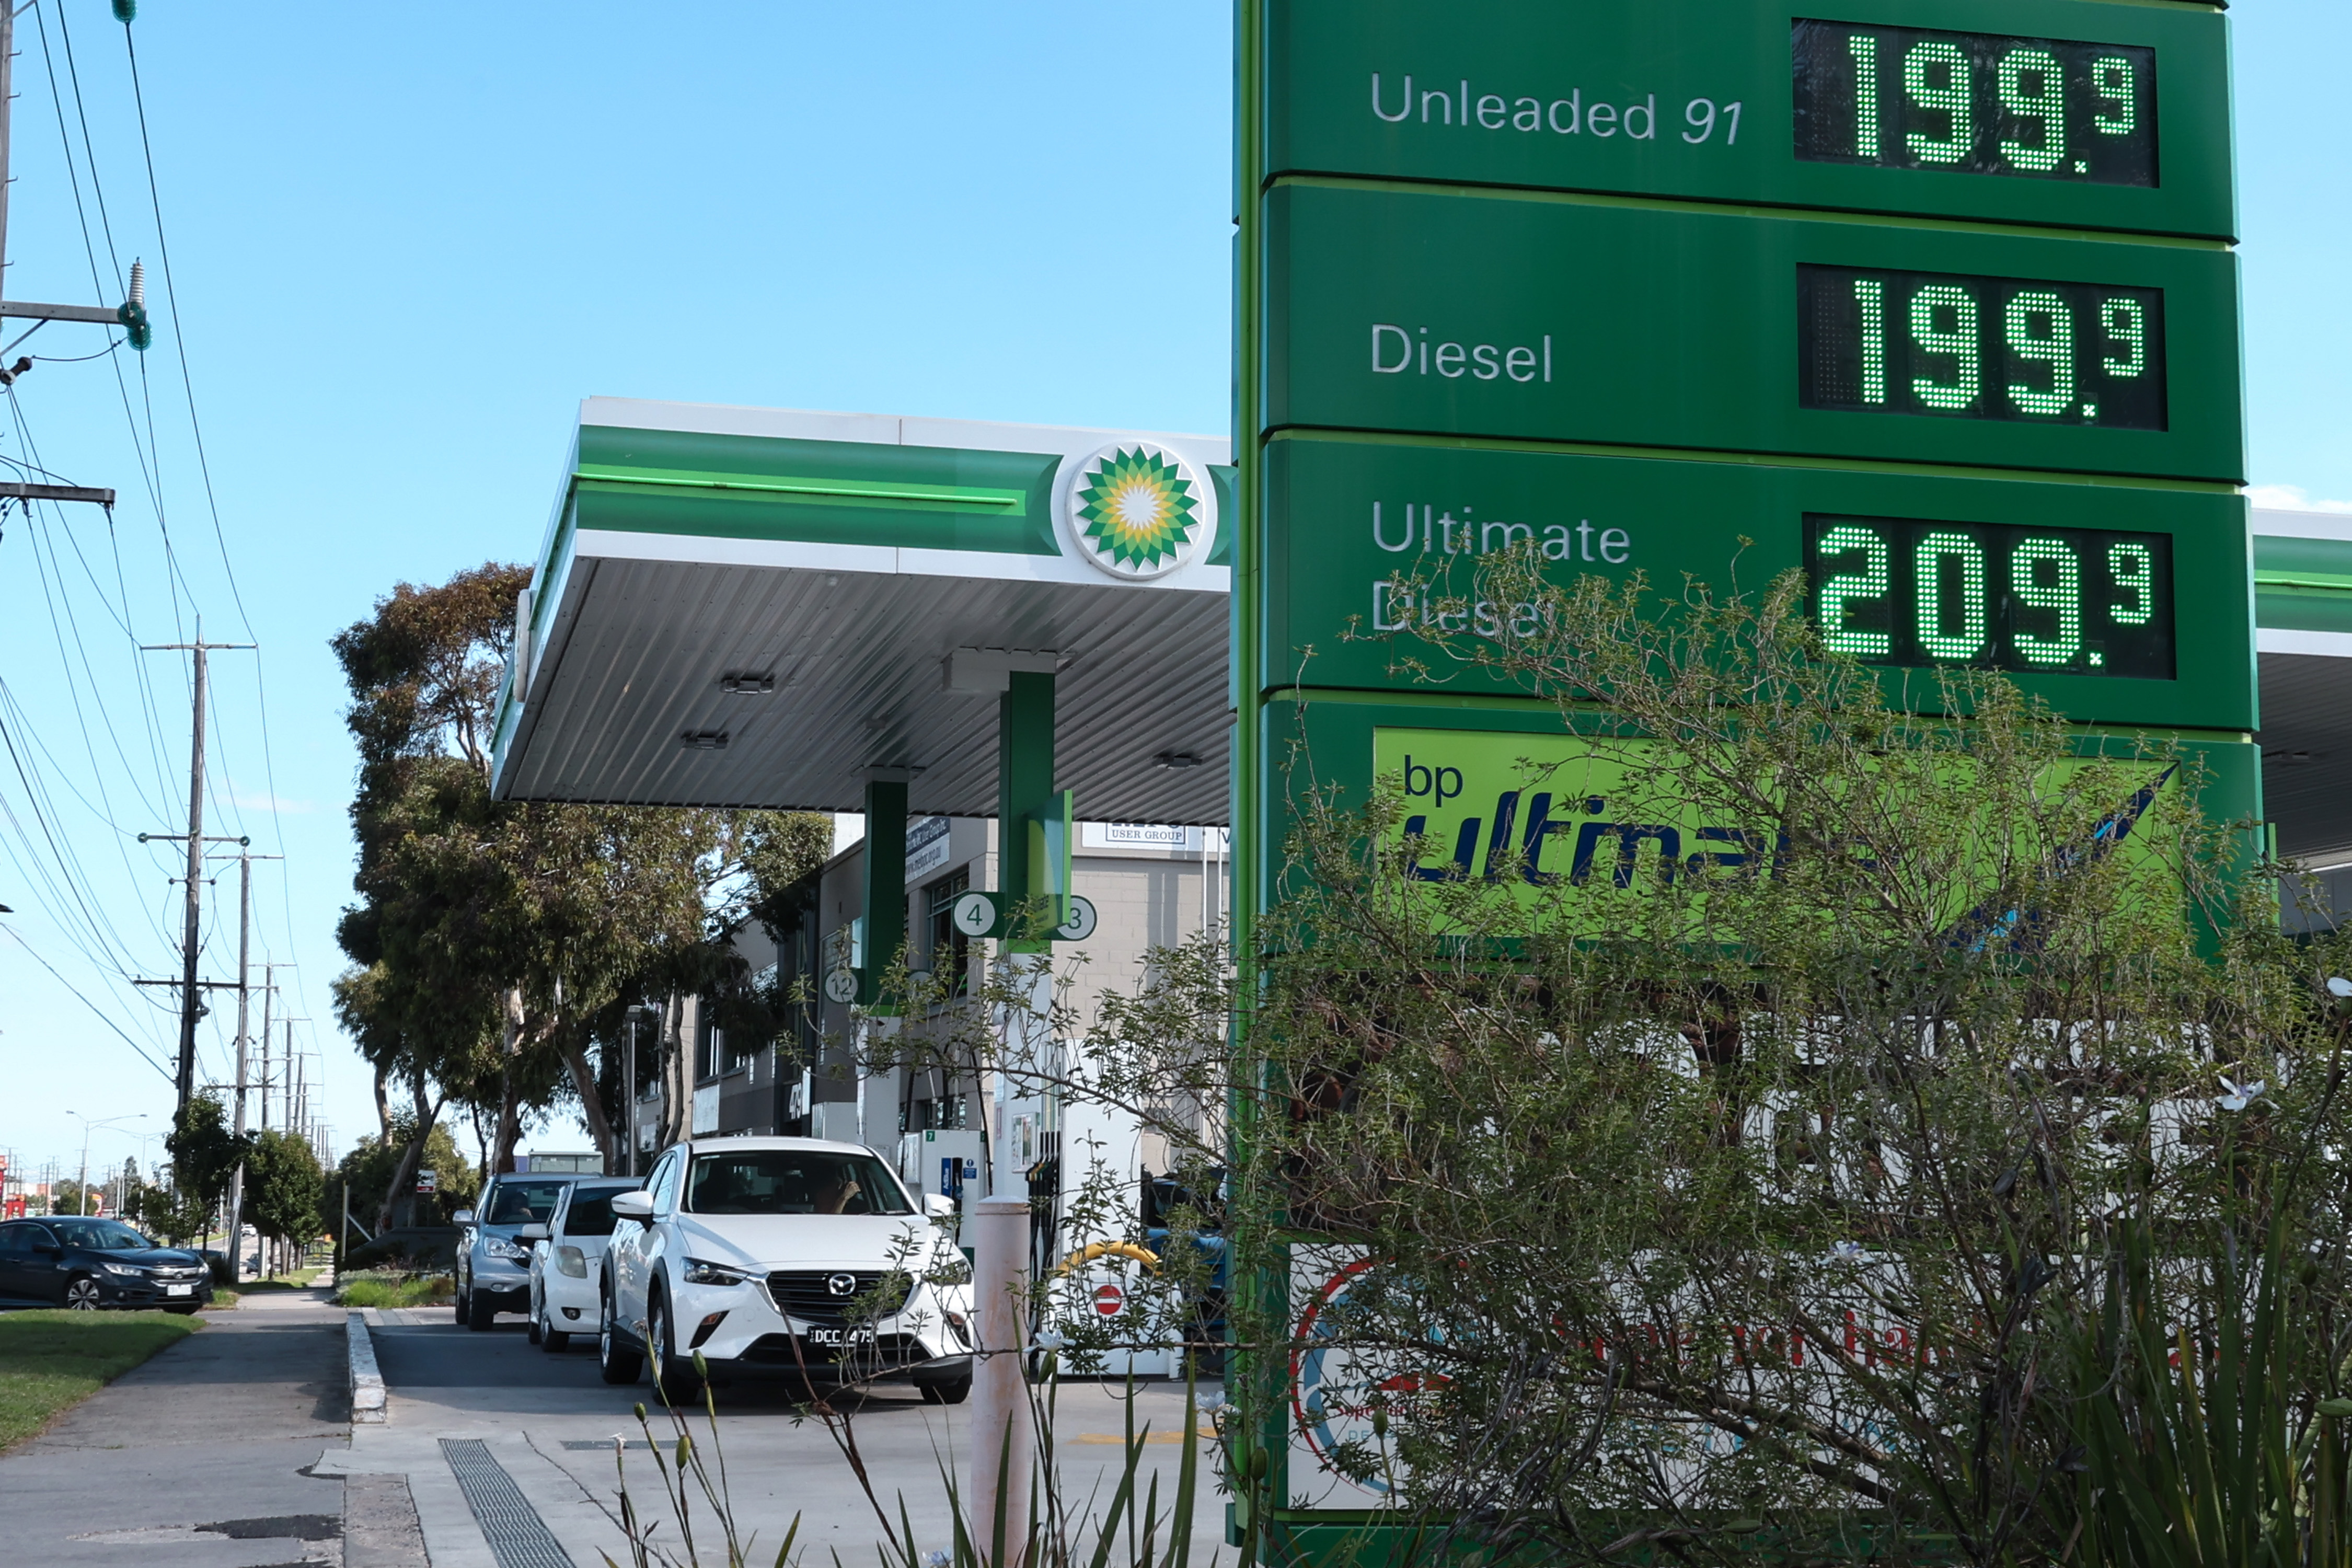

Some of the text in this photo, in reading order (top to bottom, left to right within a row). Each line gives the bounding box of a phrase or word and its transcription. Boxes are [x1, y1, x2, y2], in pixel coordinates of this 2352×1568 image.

[1371, 72, 1743, 145] Unleaded 91
[1371, 322, 1552, 383] Diesel
[1373, 500, 1631, 564] Ultimate
[1403, 754, 1463, 808] bp
[1112, 829, 1182, 841] USER GROUP
[1402, 790, 1900, 894] ultima
[966, 903, 983, 927] 4
[1066, 907, 1082, 930] 3
[831, 977, 852, 995] 12
[928, 1132, 933, 1140] 7
[815, 1330, 840, 1343] DCC
